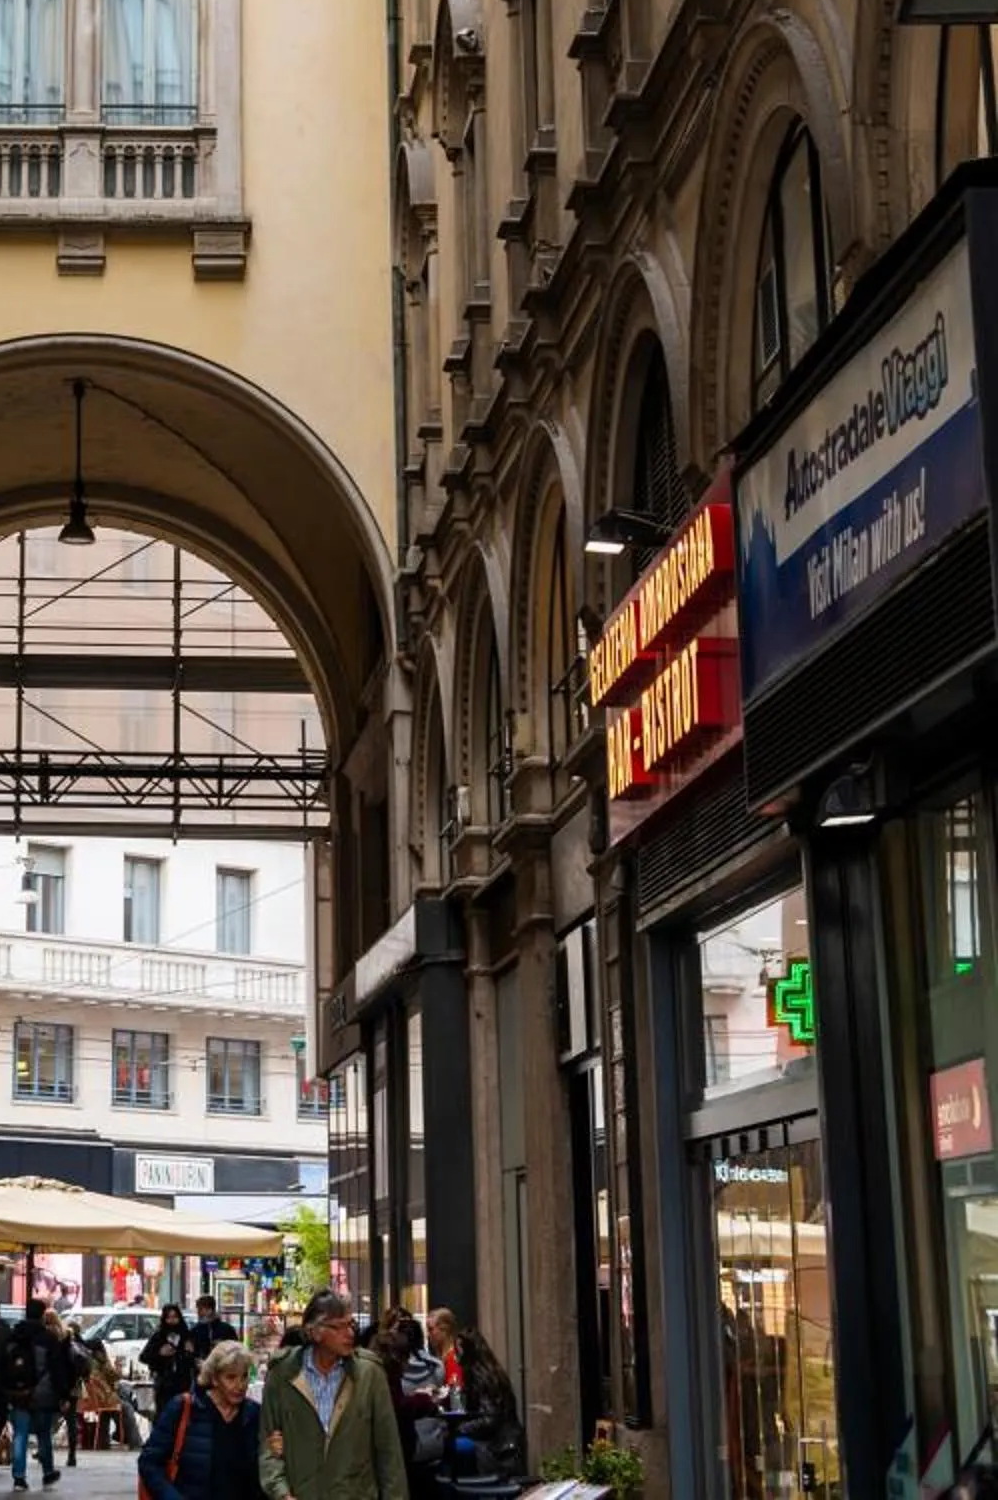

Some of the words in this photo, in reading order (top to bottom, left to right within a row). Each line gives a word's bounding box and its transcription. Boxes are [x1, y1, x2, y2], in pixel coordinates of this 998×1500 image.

[639, 506, 715, 650] AMBROSIANA
[807, 546, 831, 621] Visit
[833, 523, 868, 599] Milan
[871, 490, 901, 575] with
[904, 466, 926, 549] us!
